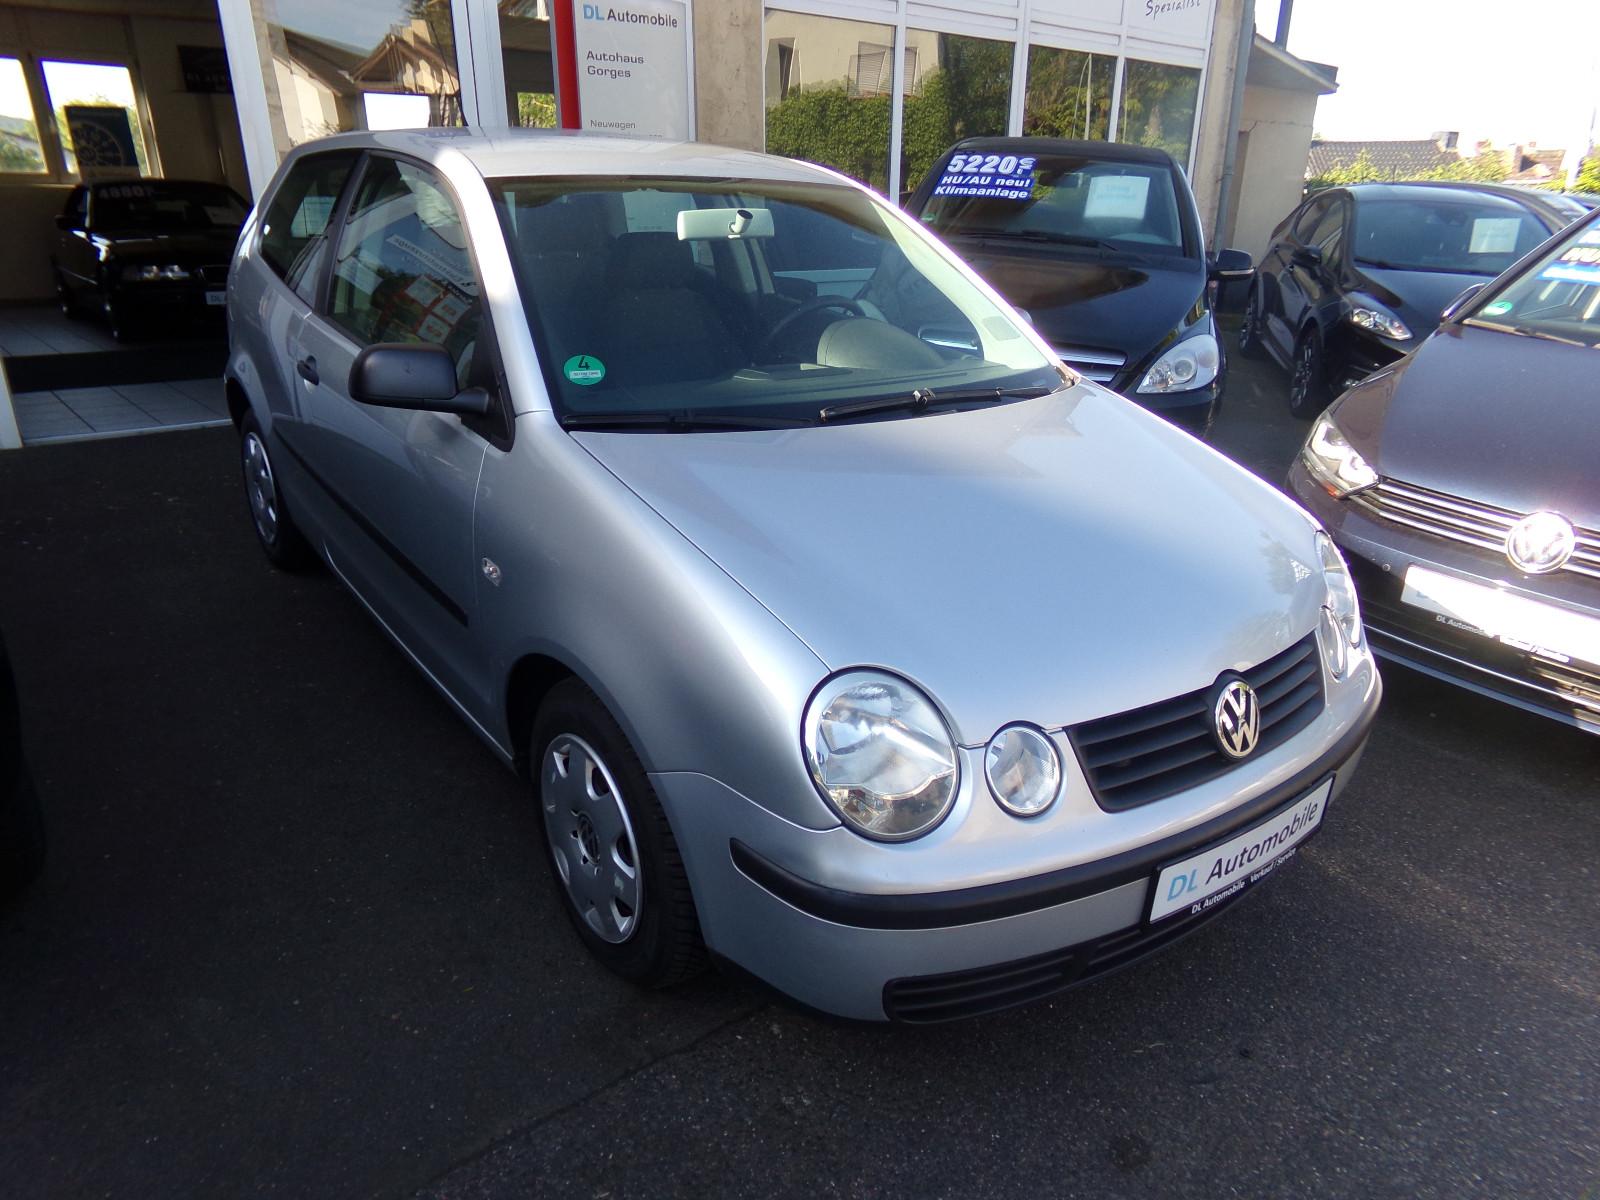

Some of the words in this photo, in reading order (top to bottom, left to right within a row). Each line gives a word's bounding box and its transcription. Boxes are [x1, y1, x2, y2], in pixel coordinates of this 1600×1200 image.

[583, 4, 605, 21] DL
[607, 8, 678, 28] Automobile
[586, 50, 644, 64] Autohaus
[587, 65, 631, 79] Gorges
[590, 119, 636, 131] Neuwagen
[941, 175, 991, 186] HU/AU
[995, 178, 1030, 188] neu!
[934, 186, 1028, 199] Klimaanlage
[578, 356, 591, 370] 4
[1216, 681, 1260, 758] VW
[1167, 868, 1198, 902] DL
[1204, 800, 1318, 885] Automobile
[1191, 902, 1203, 915] DL
[1203, 880, 1246, 909] Automobile
